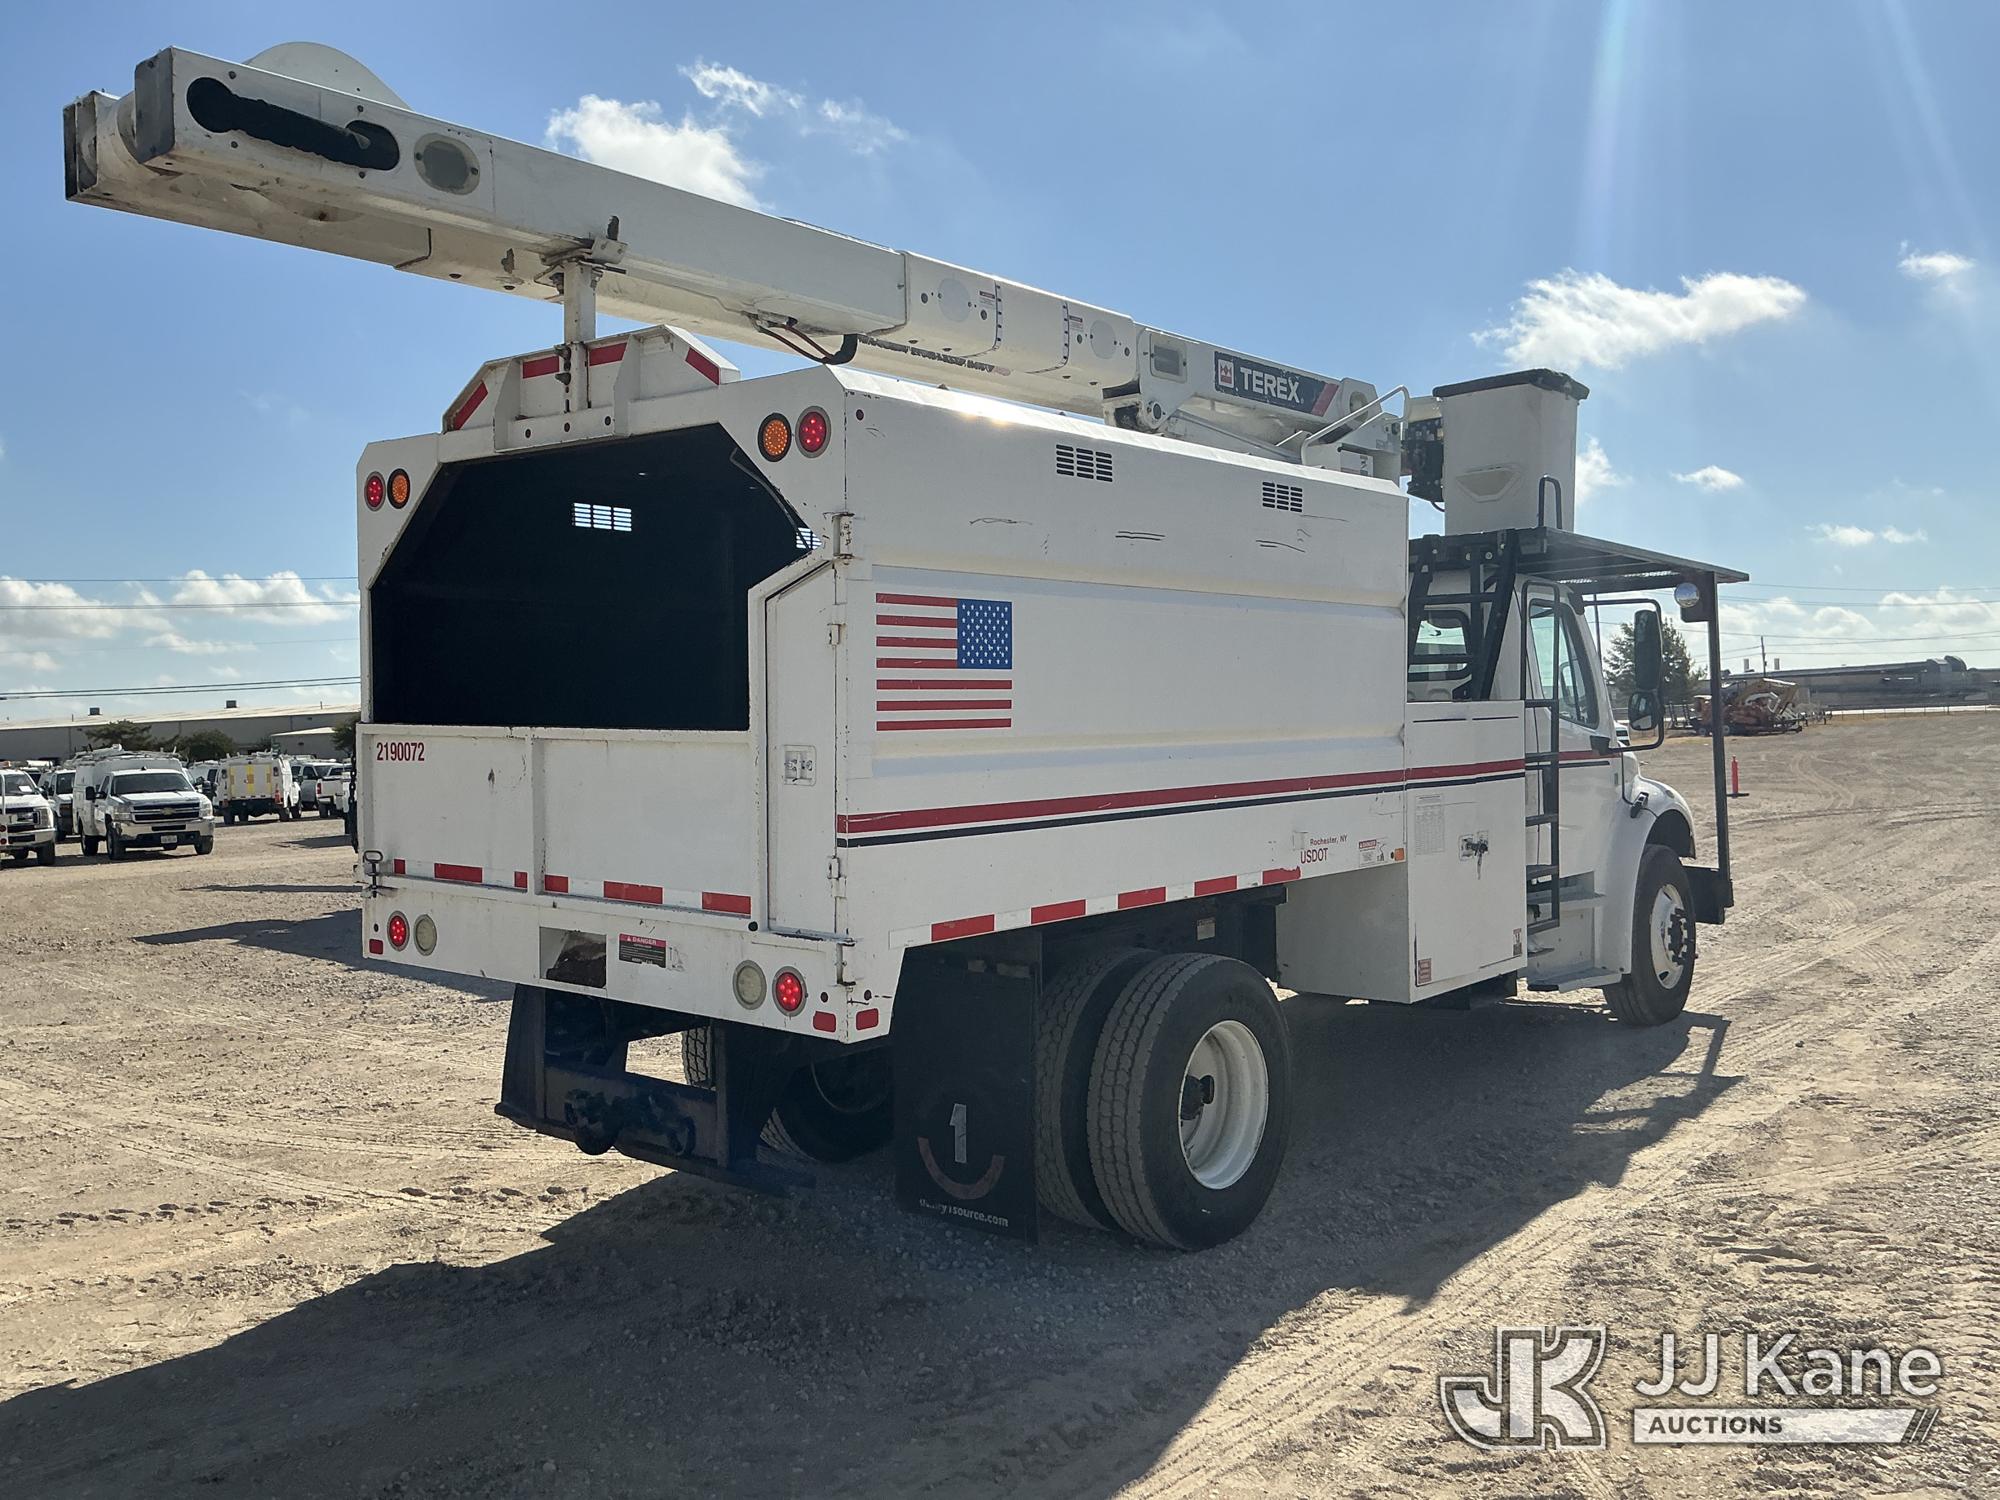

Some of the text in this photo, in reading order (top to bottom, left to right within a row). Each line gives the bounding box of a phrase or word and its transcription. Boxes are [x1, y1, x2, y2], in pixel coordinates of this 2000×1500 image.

[1240, 367, 1300, 403] TEREX
[376, 742, 425, 762] 2190072
[1340, 834, 1348, 843] NY
[1300, 848, 1329, 864] USDOT
[632, 936, 657, 945] DANGER
